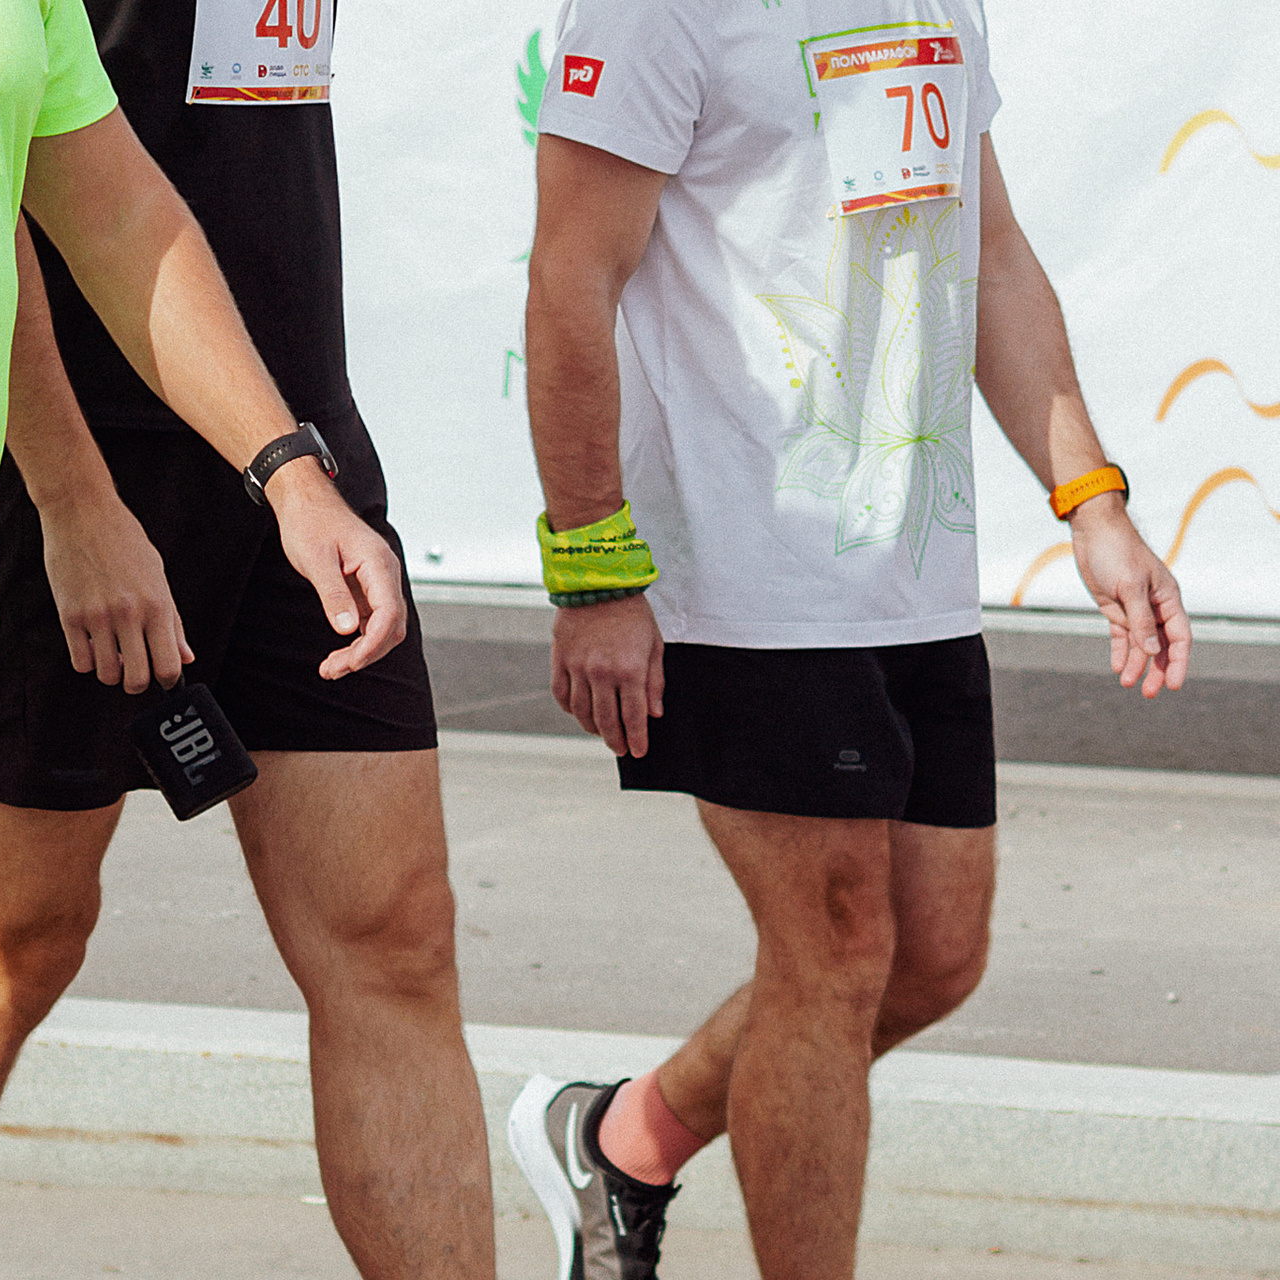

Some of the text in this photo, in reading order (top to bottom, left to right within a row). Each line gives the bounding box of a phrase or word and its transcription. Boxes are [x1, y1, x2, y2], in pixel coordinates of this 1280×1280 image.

[830, 46, 918, 69] ПОЛУМАРАФОН
[885, 82, 950, 152] 70
[159, 718, 223, 786] JBL
